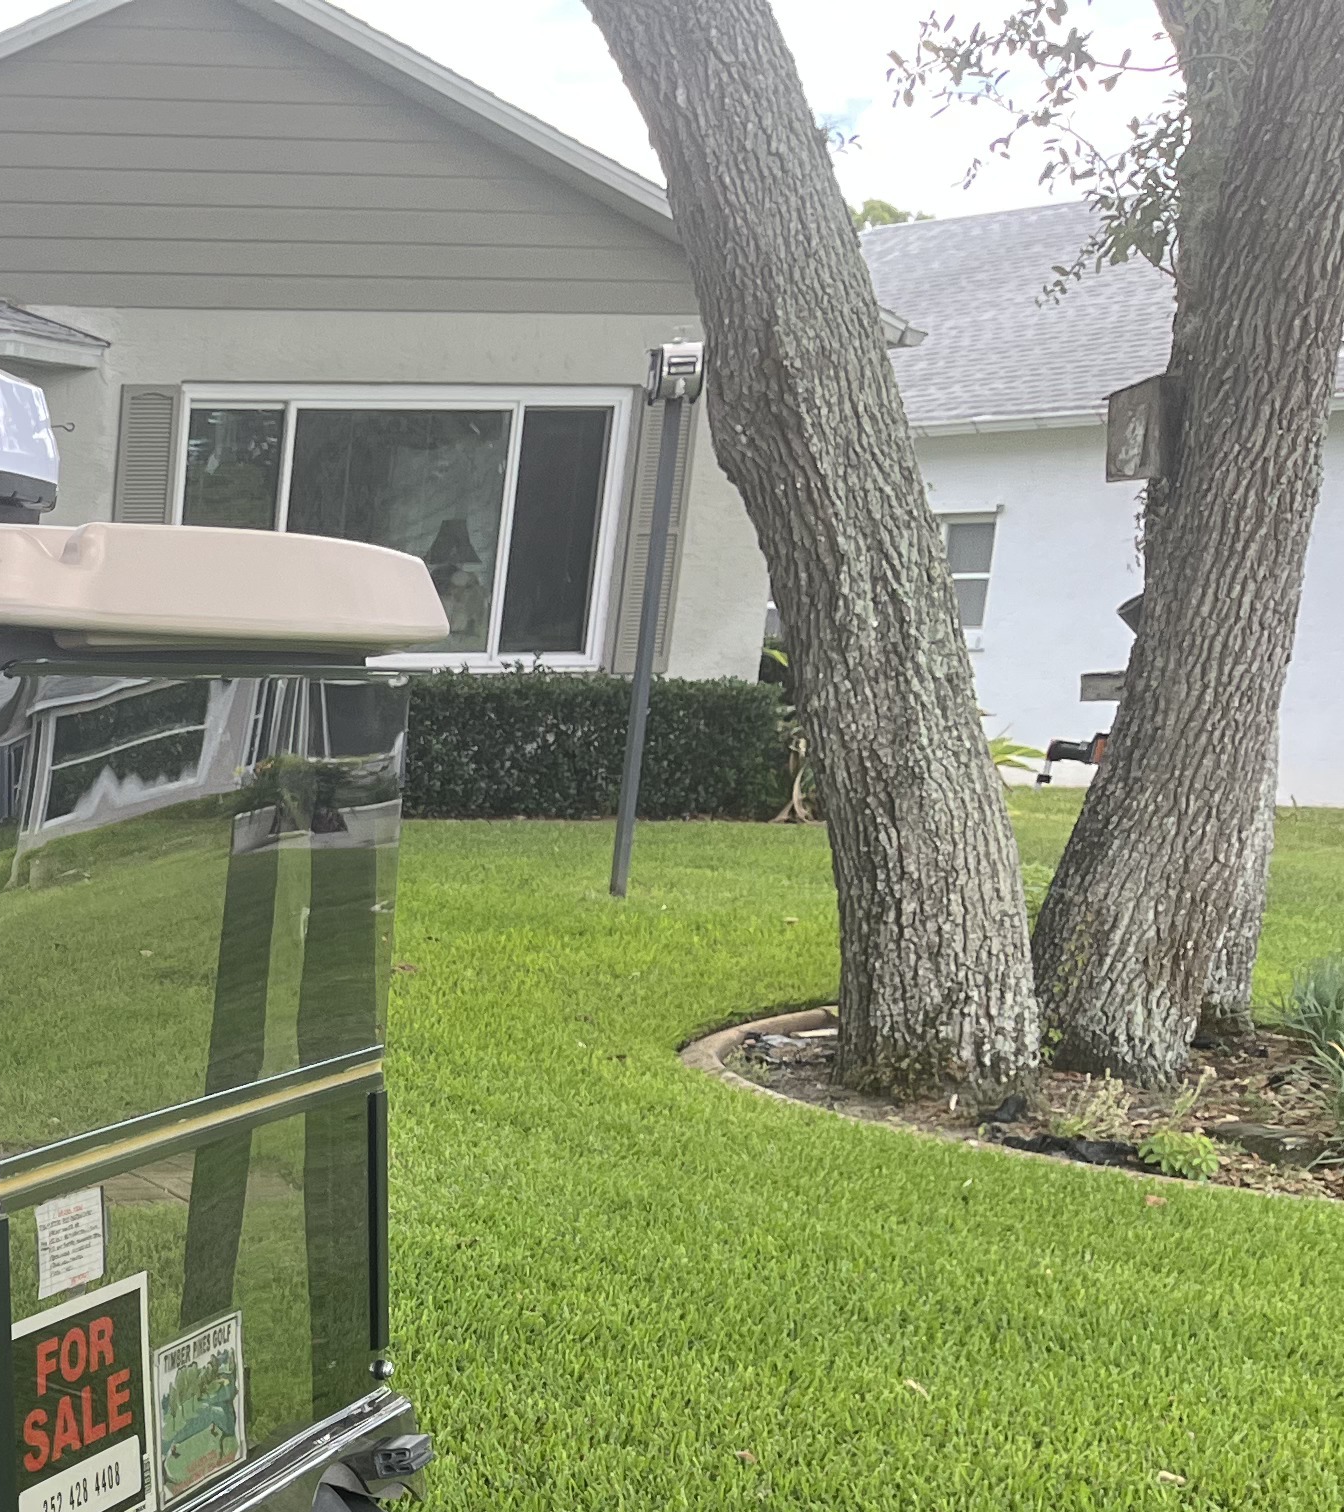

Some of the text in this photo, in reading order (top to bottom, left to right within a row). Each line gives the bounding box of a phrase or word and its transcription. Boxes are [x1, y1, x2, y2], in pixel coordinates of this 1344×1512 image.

[36, 1316, 114, 1398] FOR
[212, 1323, 231, 1349] GOLF
[23, 1367, 132, 1472] SALE
[69, 1477, 88, 1511] 428
[94, 1461, 121, 1496] 4408
